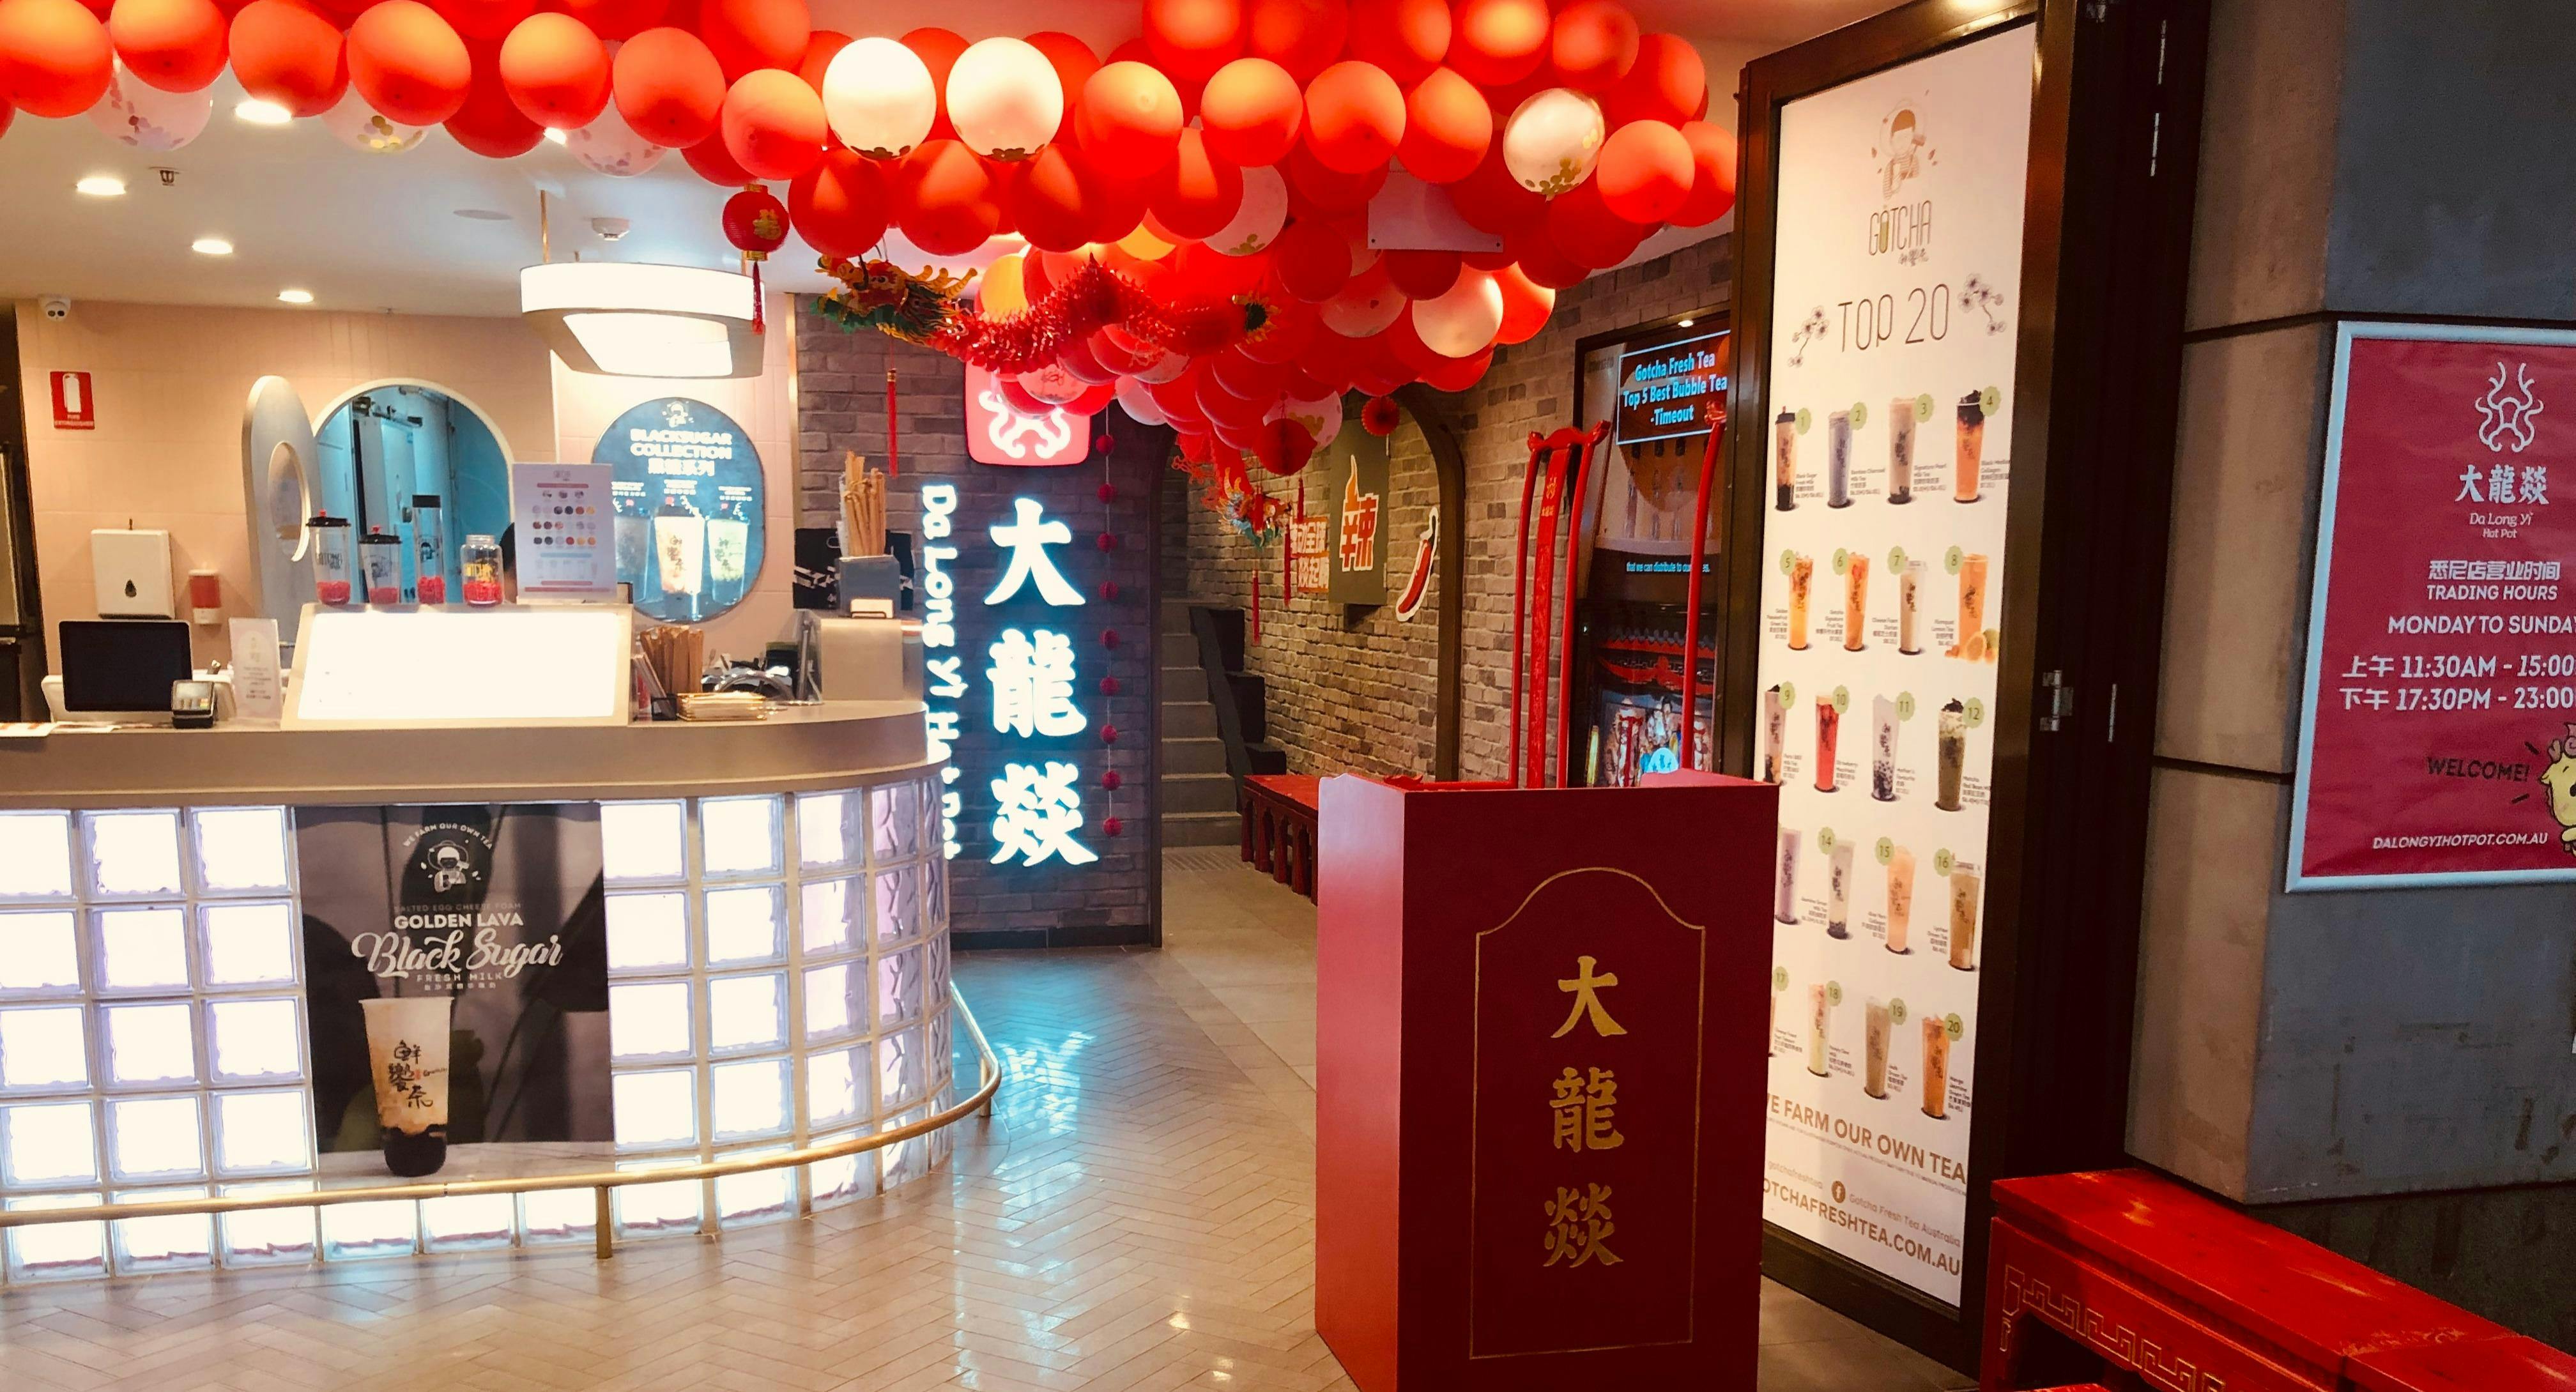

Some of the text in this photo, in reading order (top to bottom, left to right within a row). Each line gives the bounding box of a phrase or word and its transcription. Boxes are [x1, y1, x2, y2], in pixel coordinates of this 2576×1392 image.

[1869, 200, 1933, 256] GOTCHA
[1838, 284, 1950, 353] TOP 20
[1635, 360, 1667, 381] Gotcha
[1669, 353, 1695, 374] Fresh
[1697, 351, 1715, 369] Tea
[1623, 374, 1728, 411] Top 5 Best Bubble Tea
[630, 443, 732, 459] COLLECTION
[2455, 464, 2550, 505] 大龍燚
[921, 484, 958, 540] Da
[2469, 512, 2485, 525] Da
[2487, 513, 2518, 526] Long
[2483, 528, 2518, 539] Hot Pot
[2428, 560, 2561, 581] 悉尼店营业时间
[922, 546, 959, 649] Long
[2426, 585, 2559, 600] TRADING HOURS
[2388, 615, 2576, 634] MONDAY TO SUNDA
[2342, 655, 2395, 678] 上午
[2400, 655, 2497, 678] 11:30AM
[983, 497, 1100, 868] 大龍燚
[1836, 694, 1846, 705] 10
[1899, 701, 1909, 713] 11
[2339, 688, 2389, 710] 下午
[2396, 688, 2492, 711] 17:30PM
[1968, 707, 1980, 720] 12
[2427, 756, 2531, 782] WELCOME!
[415, 823, 437, 837] FARM
[439, 822, 458, 830] OUR
[460, 824, 480, 838] OWN
[480, 835, 493, 850] TEA
[1821, 836, 1832, 847] 14
[2373, 832, 2548, 850] DALONGYIHOTPOT.COM.AU
[1879, 845, 1890, 858] 15
[1936, 855, 1949, 869] 16
[394, 912, 524, 929] GOLDEN LAVA
[351, 928, 564, 979] Black Sugar
[417, 972, 502, 983] FRESH MILK
[1829, 988, 1839, 1000] 18
[1892, 1006, 1903, 1017] 19
[1947, 1021, 1960, 1034] 20
[1542, 955, 1629, 1269] 大龍燚
[1767, 1093, 1779, 1114] E
[1784, 1099, 1830, 1133] FARM
[1834, 1119, 1872, 1149] OUR
[1877, 1134, 1924, 1169] OWN
[1929, 1152, 1967, 1184] TEA
[1849, 1193, 1961, 1248] Gotcha Fresh Tea Australia
